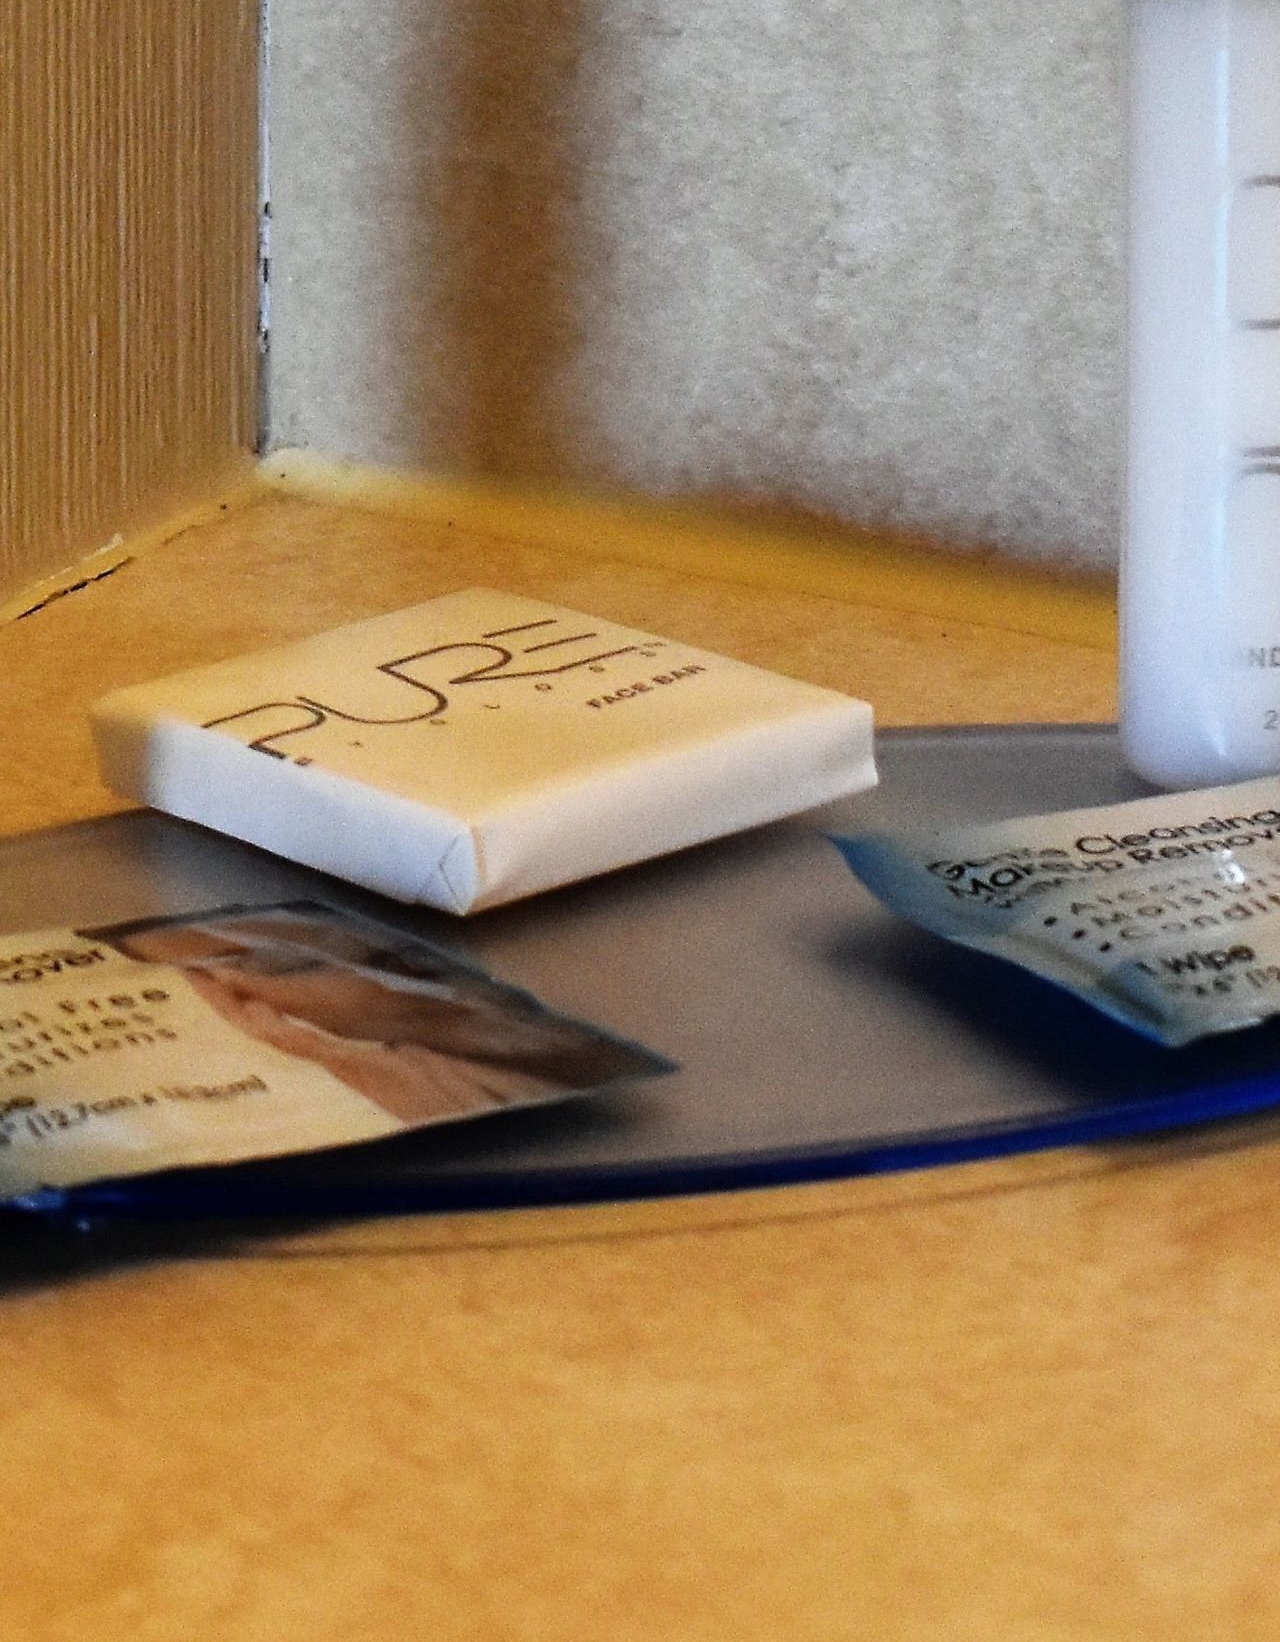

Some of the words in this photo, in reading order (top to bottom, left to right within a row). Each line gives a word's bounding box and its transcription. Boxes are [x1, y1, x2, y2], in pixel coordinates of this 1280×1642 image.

[199, 619, 639, 760] PURE
[586, 678, 651, 711] FACE
[651, 663, 707, 688] BAR
[1161, 945, 1257, 976] Wipe
